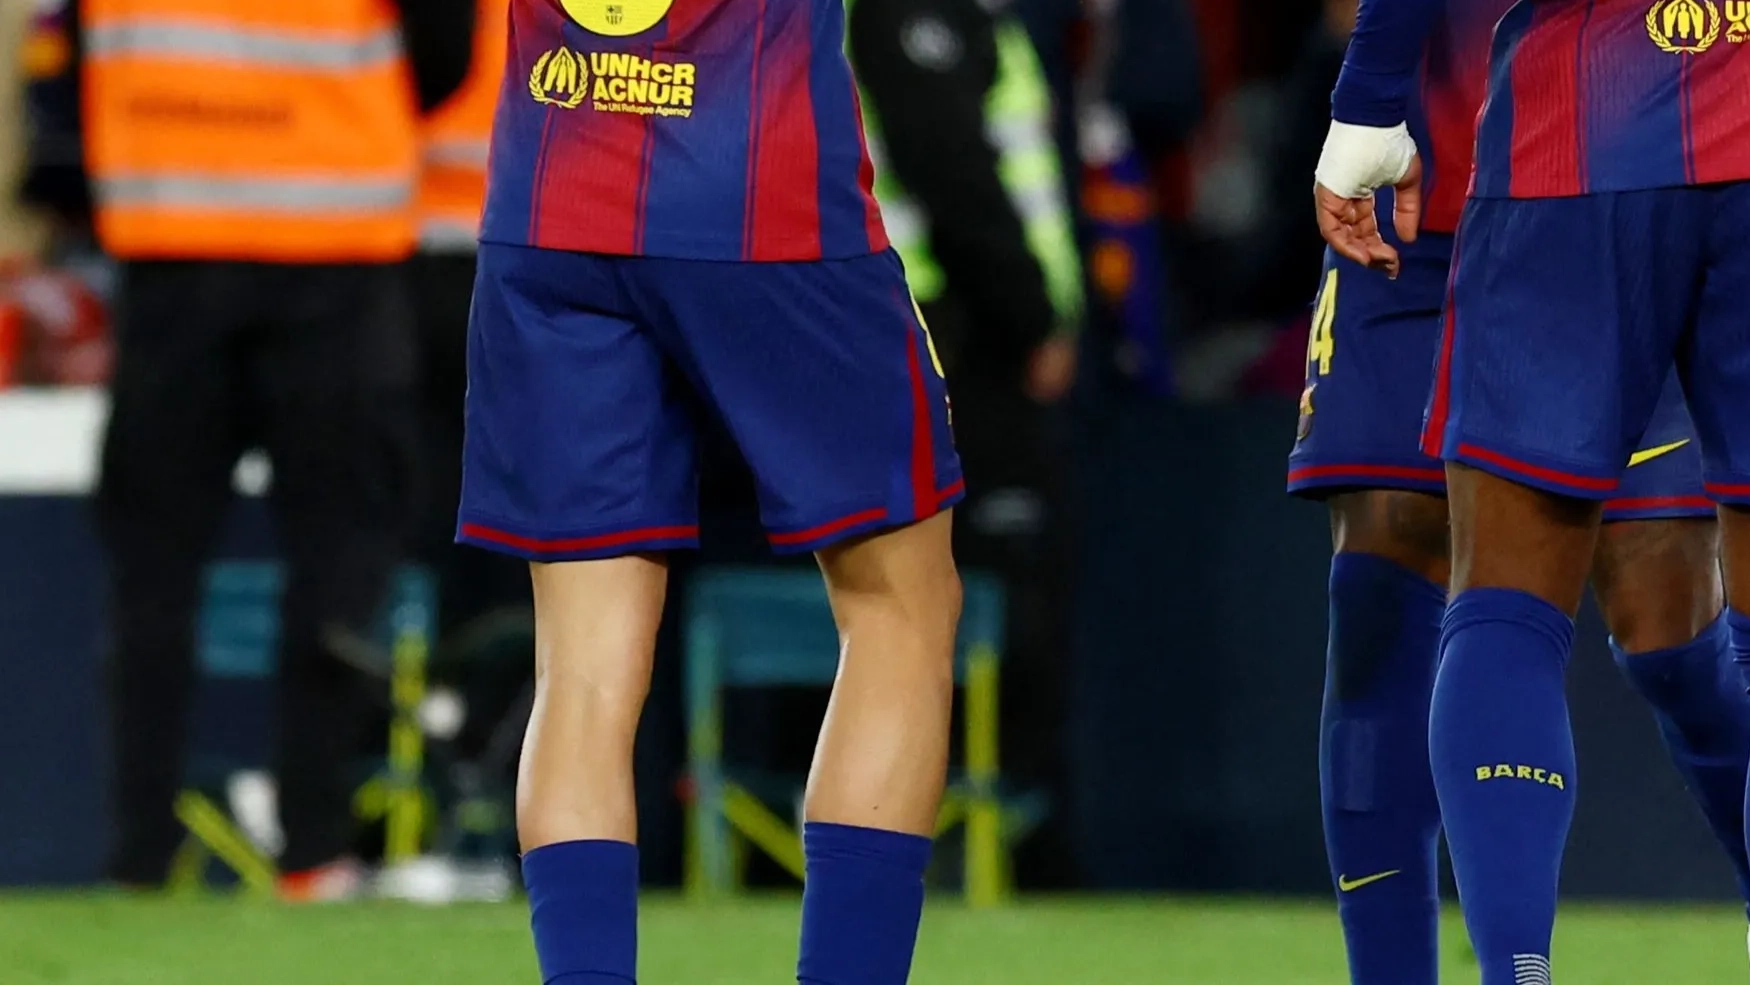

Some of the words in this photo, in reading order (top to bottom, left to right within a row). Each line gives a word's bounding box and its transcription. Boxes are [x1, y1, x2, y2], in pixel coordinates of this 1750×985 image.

[1727, 33, 1743, 43] The
[590, 52, 696, 85] UNHCR
[592, 77, 694, 106] ACNUR
[593, 101, 608, 111] The
[608, 102, 621, 112] UN
[622, 103, 654, 116] Refugee
[655, 105, 692, 118] Agency
[1307, 268, 1338, 375] 4
[1475, 764, 1564, 790] BARÇA
